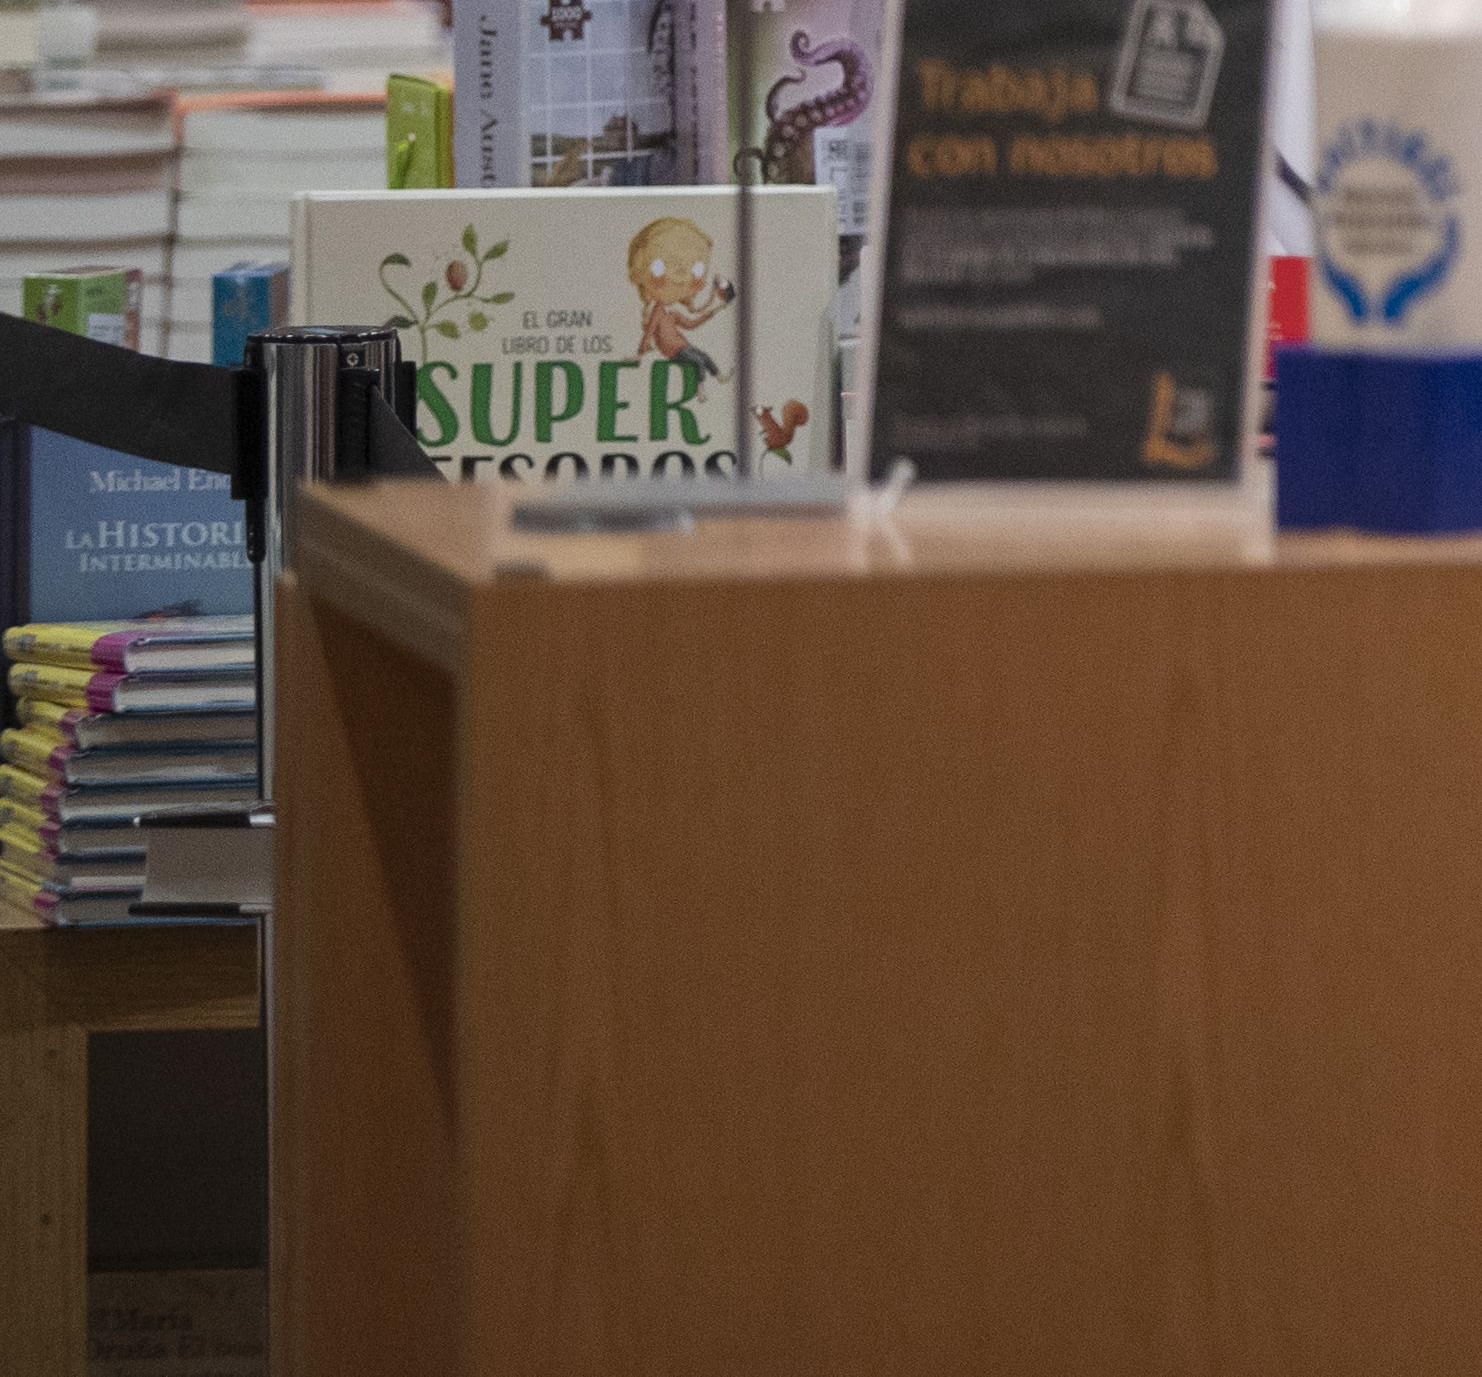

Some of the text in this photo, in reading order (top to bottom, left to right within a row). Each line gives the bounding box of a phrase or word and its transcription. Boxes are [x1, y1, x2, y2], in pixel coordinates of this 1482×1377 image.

[919, 58, 1098, 125] Trabaja
[905, 131, 1219, 180] con nosotros
[522, 309, 594, 329] EL GRAN
[502, 335, 613, 354] LIBRO DE LOS
[415, 359, 712, 448] SUPER
[90, 469, 181, 492] Michael
[65, 521, 244, 548] LA HISTORI
[79, 552, 248, 573] INTERMINABL
